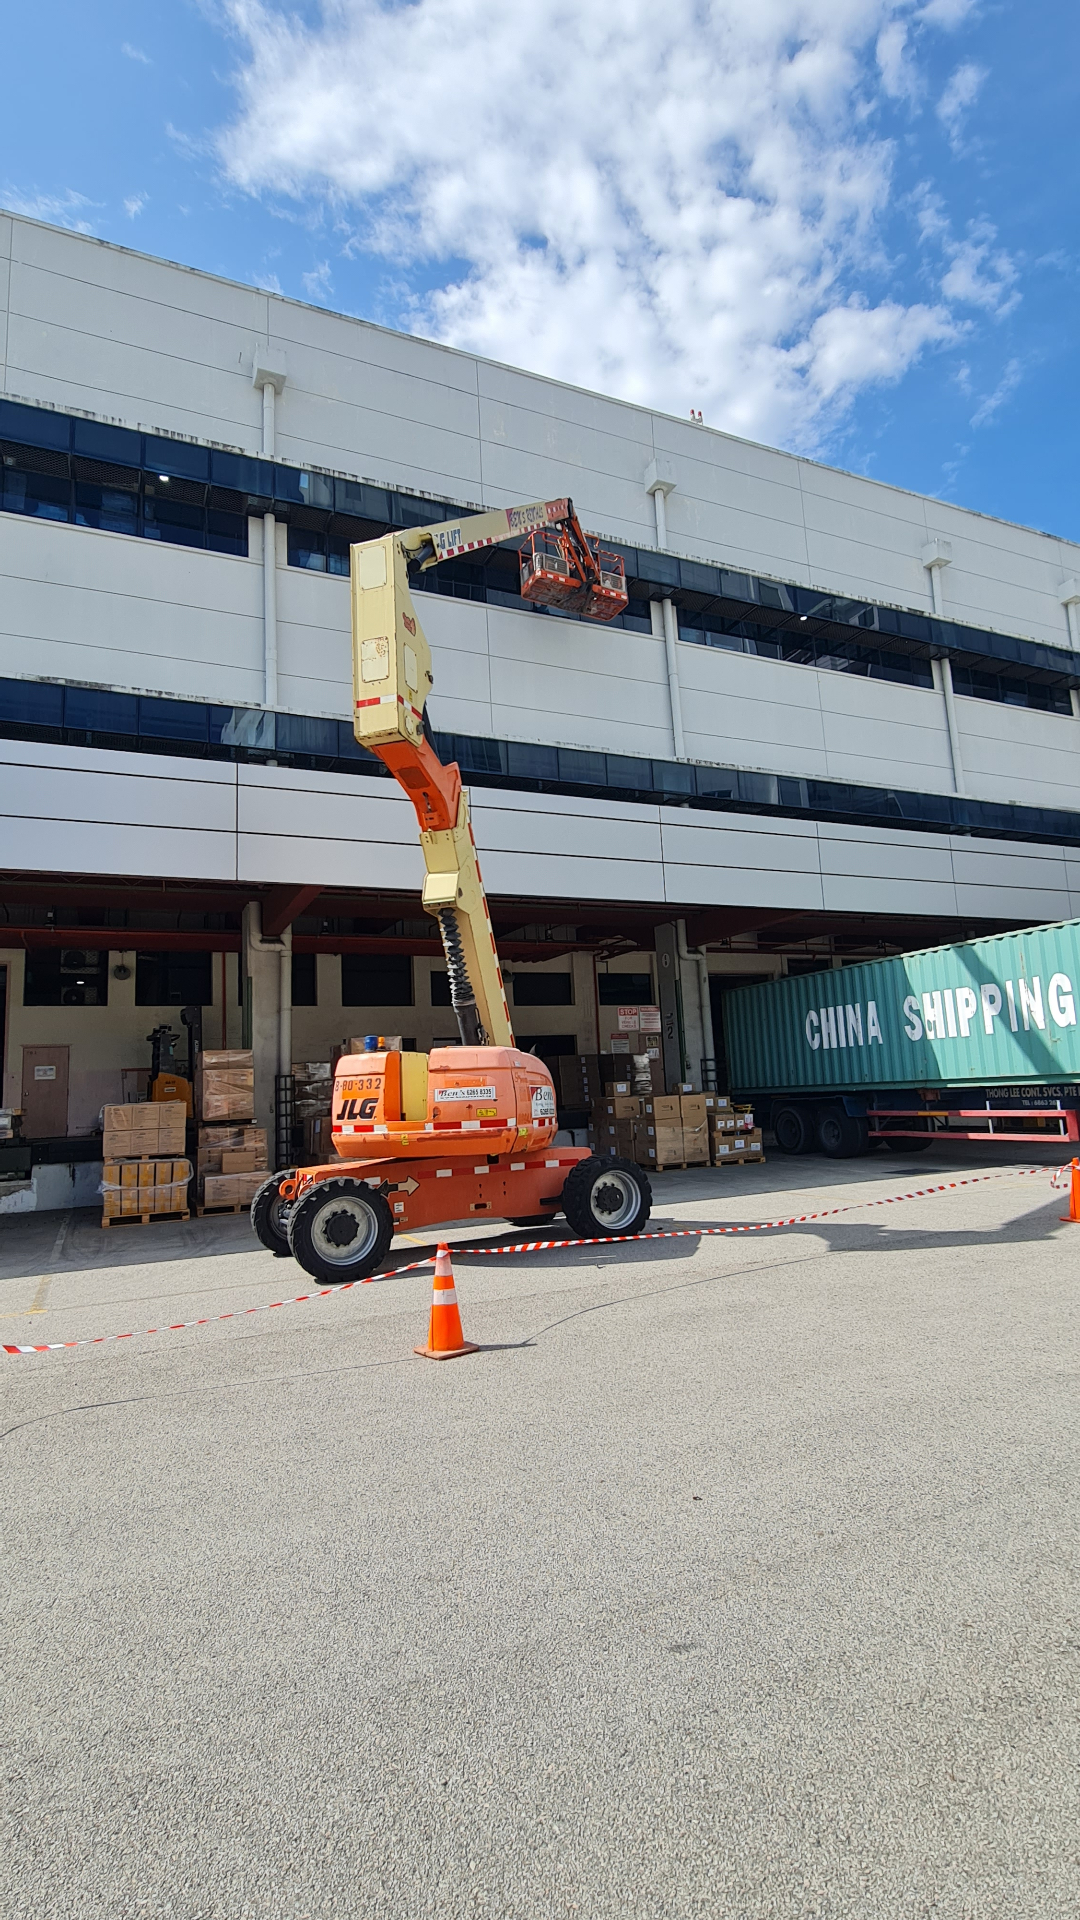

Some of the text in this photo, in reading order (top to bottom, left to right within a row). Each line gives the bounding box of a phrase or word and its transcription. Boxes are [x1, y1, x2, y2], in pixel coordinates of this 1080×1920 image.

[446, 529, 461, 547] LIFT
[805, 972, 1077, 1050] CHINA SHIPPING
[985, 1088, 1008, 1098] THONG
[1009, 1087, 1020, 1097] LEE
[1064, 1086, 1078, 1096] PTE
[336, 1097, 379, 1120] JLG
